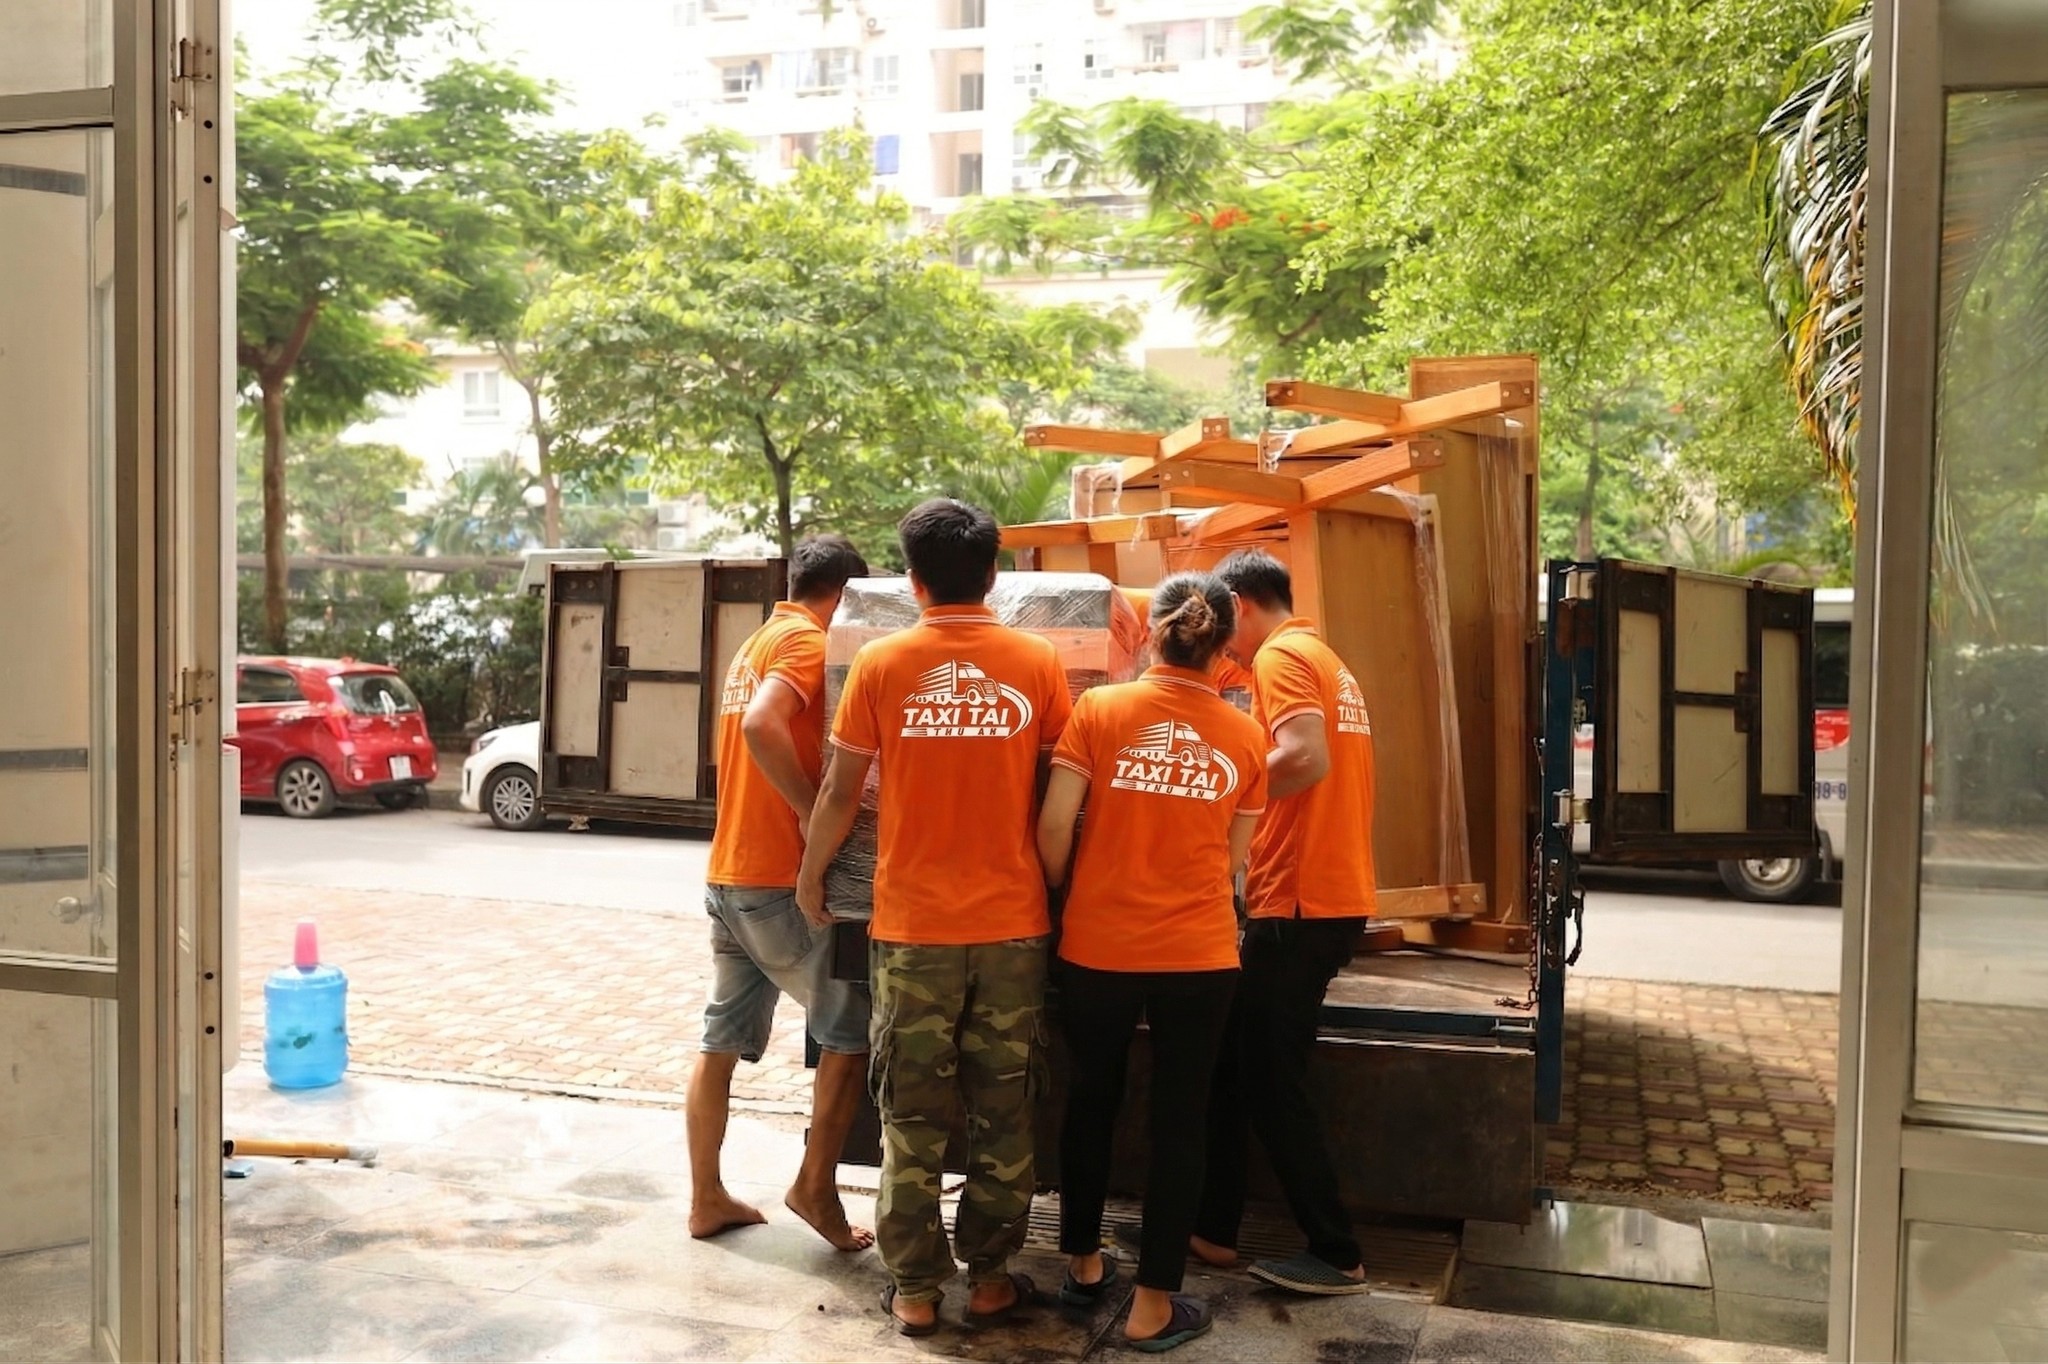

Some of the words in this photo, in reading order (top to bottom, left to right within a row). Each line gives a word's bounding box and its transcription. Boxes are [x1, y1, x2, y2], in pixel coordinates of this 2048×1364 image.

[903, 707, 962, 726] TAXI
[968, 707, 1009, 725] TAI
[1115, 760, 1173, 783] TAXI
[1179, 768, 1219, 789] TAI
